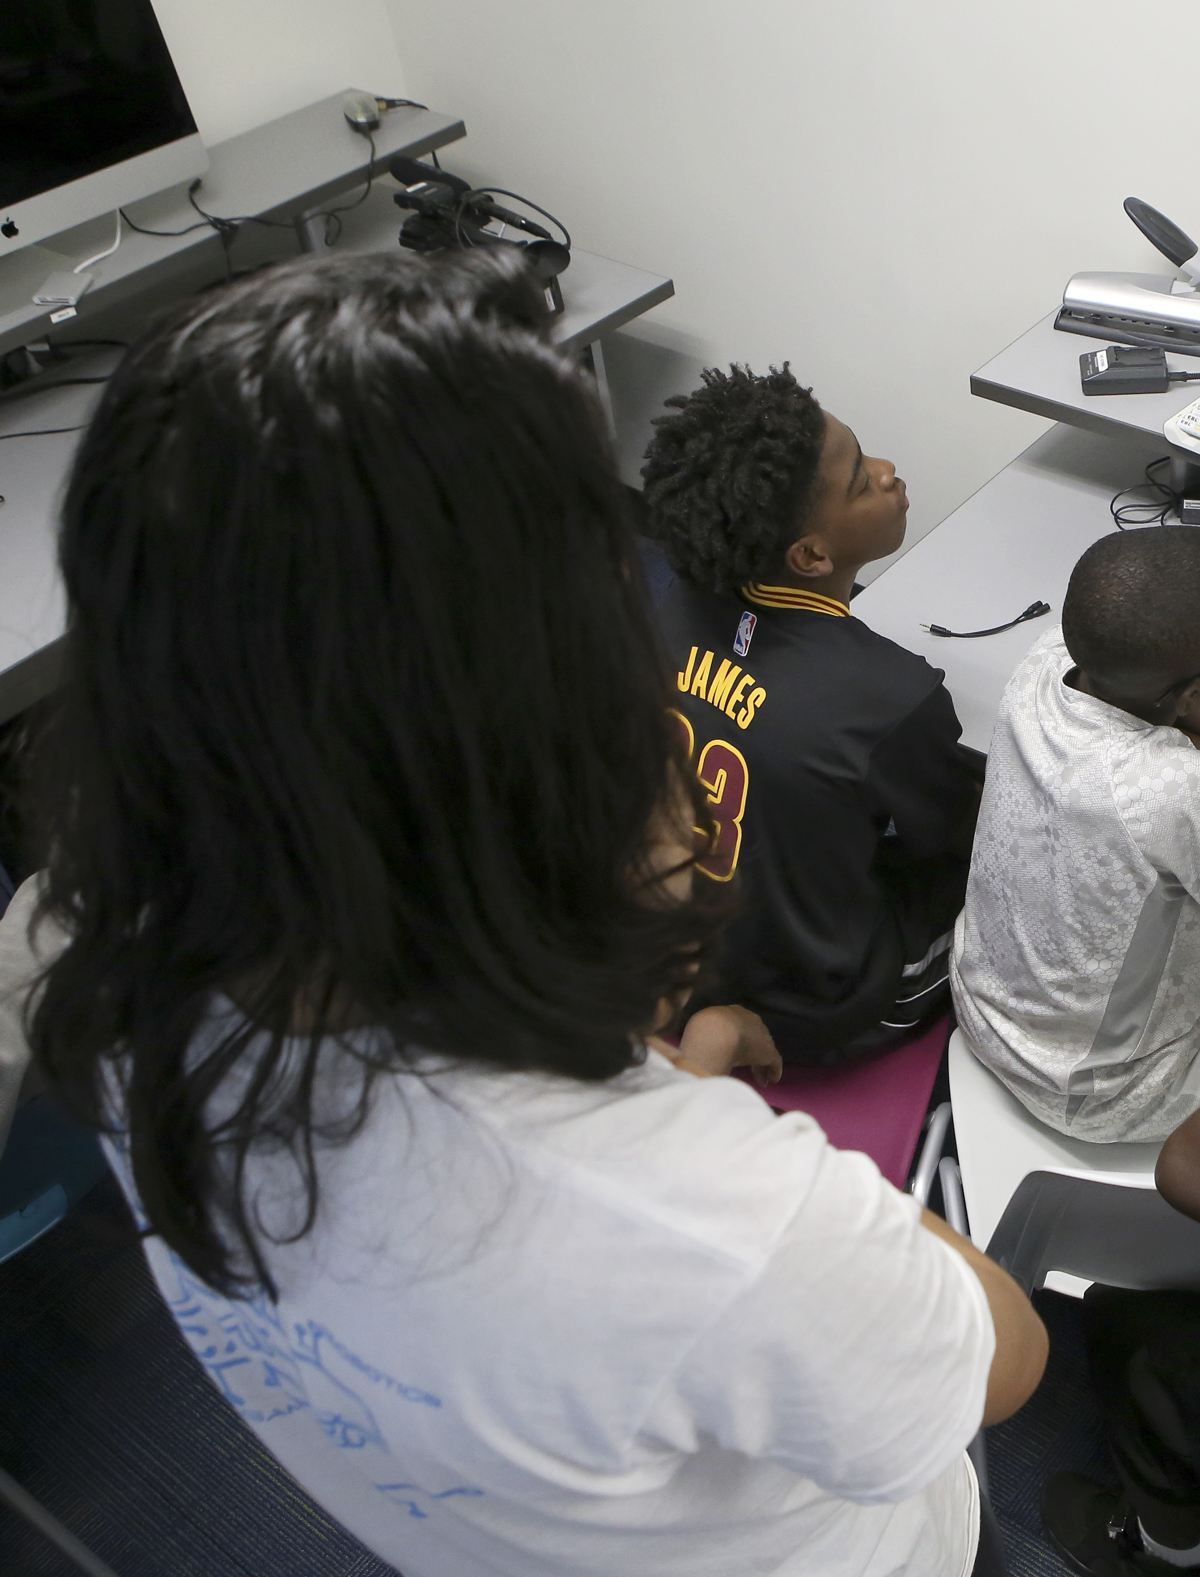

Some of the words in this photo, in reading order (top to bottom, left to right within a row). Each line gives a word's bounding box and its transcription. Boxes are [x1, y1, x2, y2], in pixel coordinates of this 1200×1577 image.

[1180, 419, 1192, 427] EBL
[1187, 415, 1199, 423] EBL
[677, 646, 767, 730] JAMES
